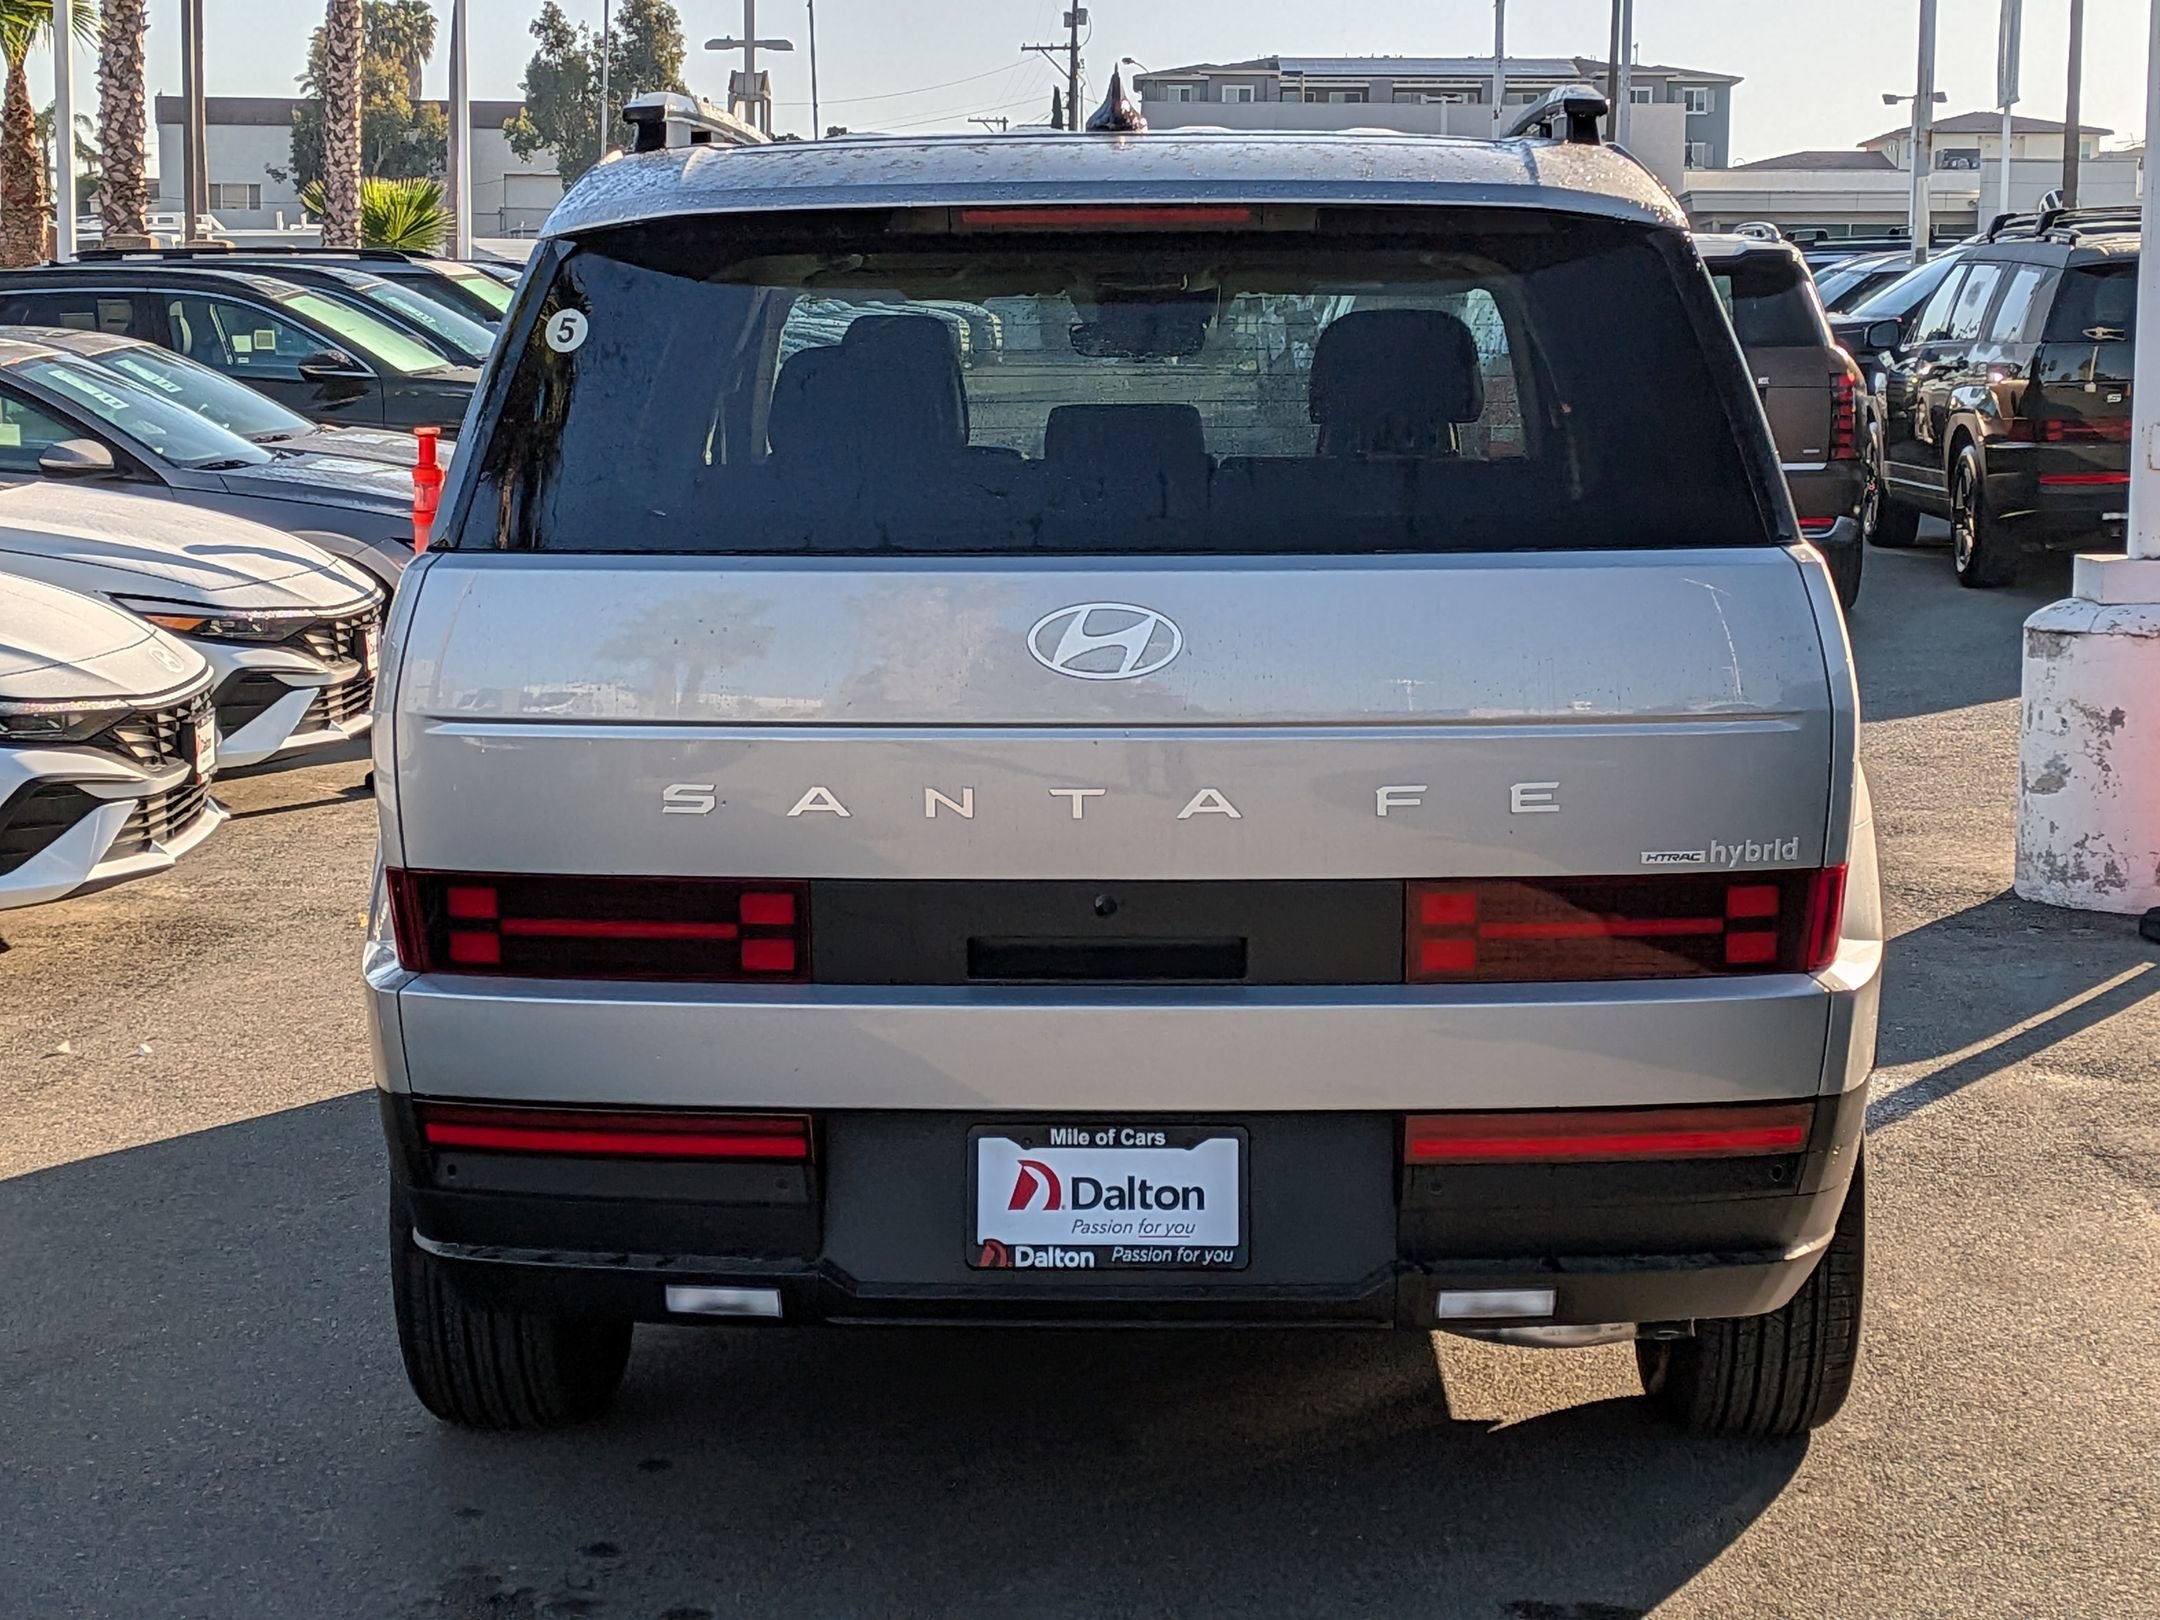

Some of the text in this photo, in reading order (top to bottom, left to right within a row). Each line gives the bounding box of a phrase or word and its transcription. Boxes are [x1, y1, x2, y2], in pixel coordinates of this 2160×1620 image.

[556, 316, 577, 344] 5
[662, 781, 1560, 819] SANTA FE
[1645, 836, 1799, 869] HTRAC hybrid
[1050, 1128, 1166, 1146] Mile of Cars
[1070, 1175, 1206, 1211] Dalton
[1071, 1218, 1196, 1237] Passion for you
[1014, 1246, 1096, 1268] Dalton
[1111, 1246, 1234, 1266] Passion for you
